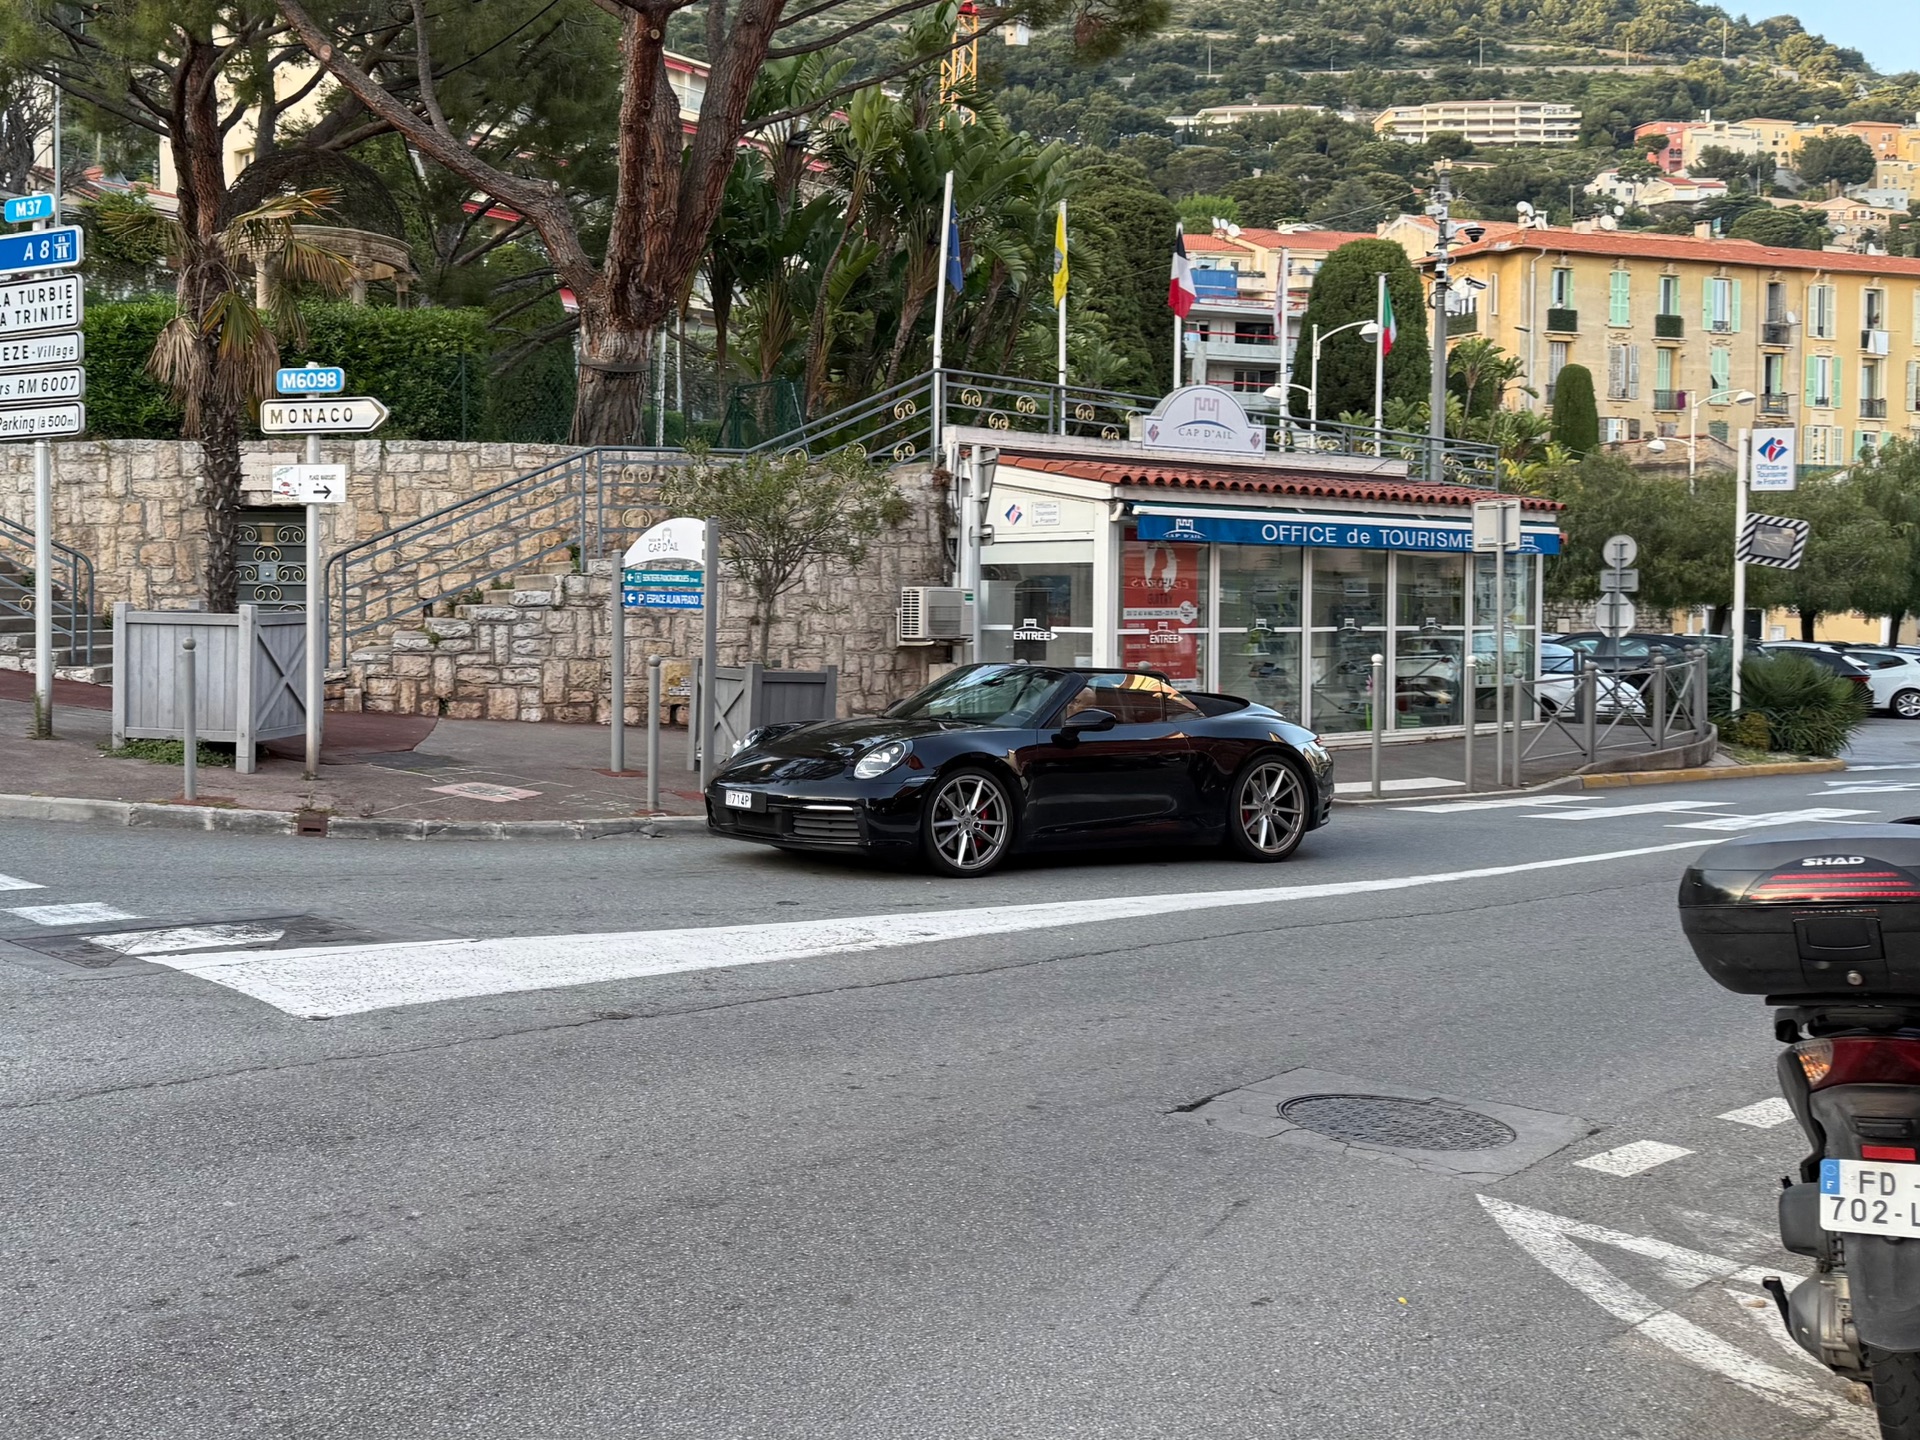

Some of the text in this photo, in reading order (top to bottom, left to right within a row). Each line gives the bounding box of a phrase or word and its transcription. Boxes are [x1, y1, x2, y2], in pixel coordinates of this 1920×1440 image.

[15, 199, 42, 218] M37
[23, 240, 50, 261] A 8
[0, 284, 73, 307] A TURBIE
[15, 300, 73, 325] TRINITÉ
[17, 378, 37, 394] RM
[41, 375, 77, 392] 6007
[282, 371, 337, 389] M6098
[270, 407, 353, 425] MONACO
[1178, 427, 1233, 440] CAP D'AIL
[1757, 470, 1788, 478] Tourisme
[1261, 523, 1473, 549] OFFICE de TOURISME
[1013, 631, 1051, 641] ENTREE
[1149, 634, 1179, 644] ENTREE
[731, 793, 750, 806] 714P
[1801, 856, 1866, 867] SHAD
